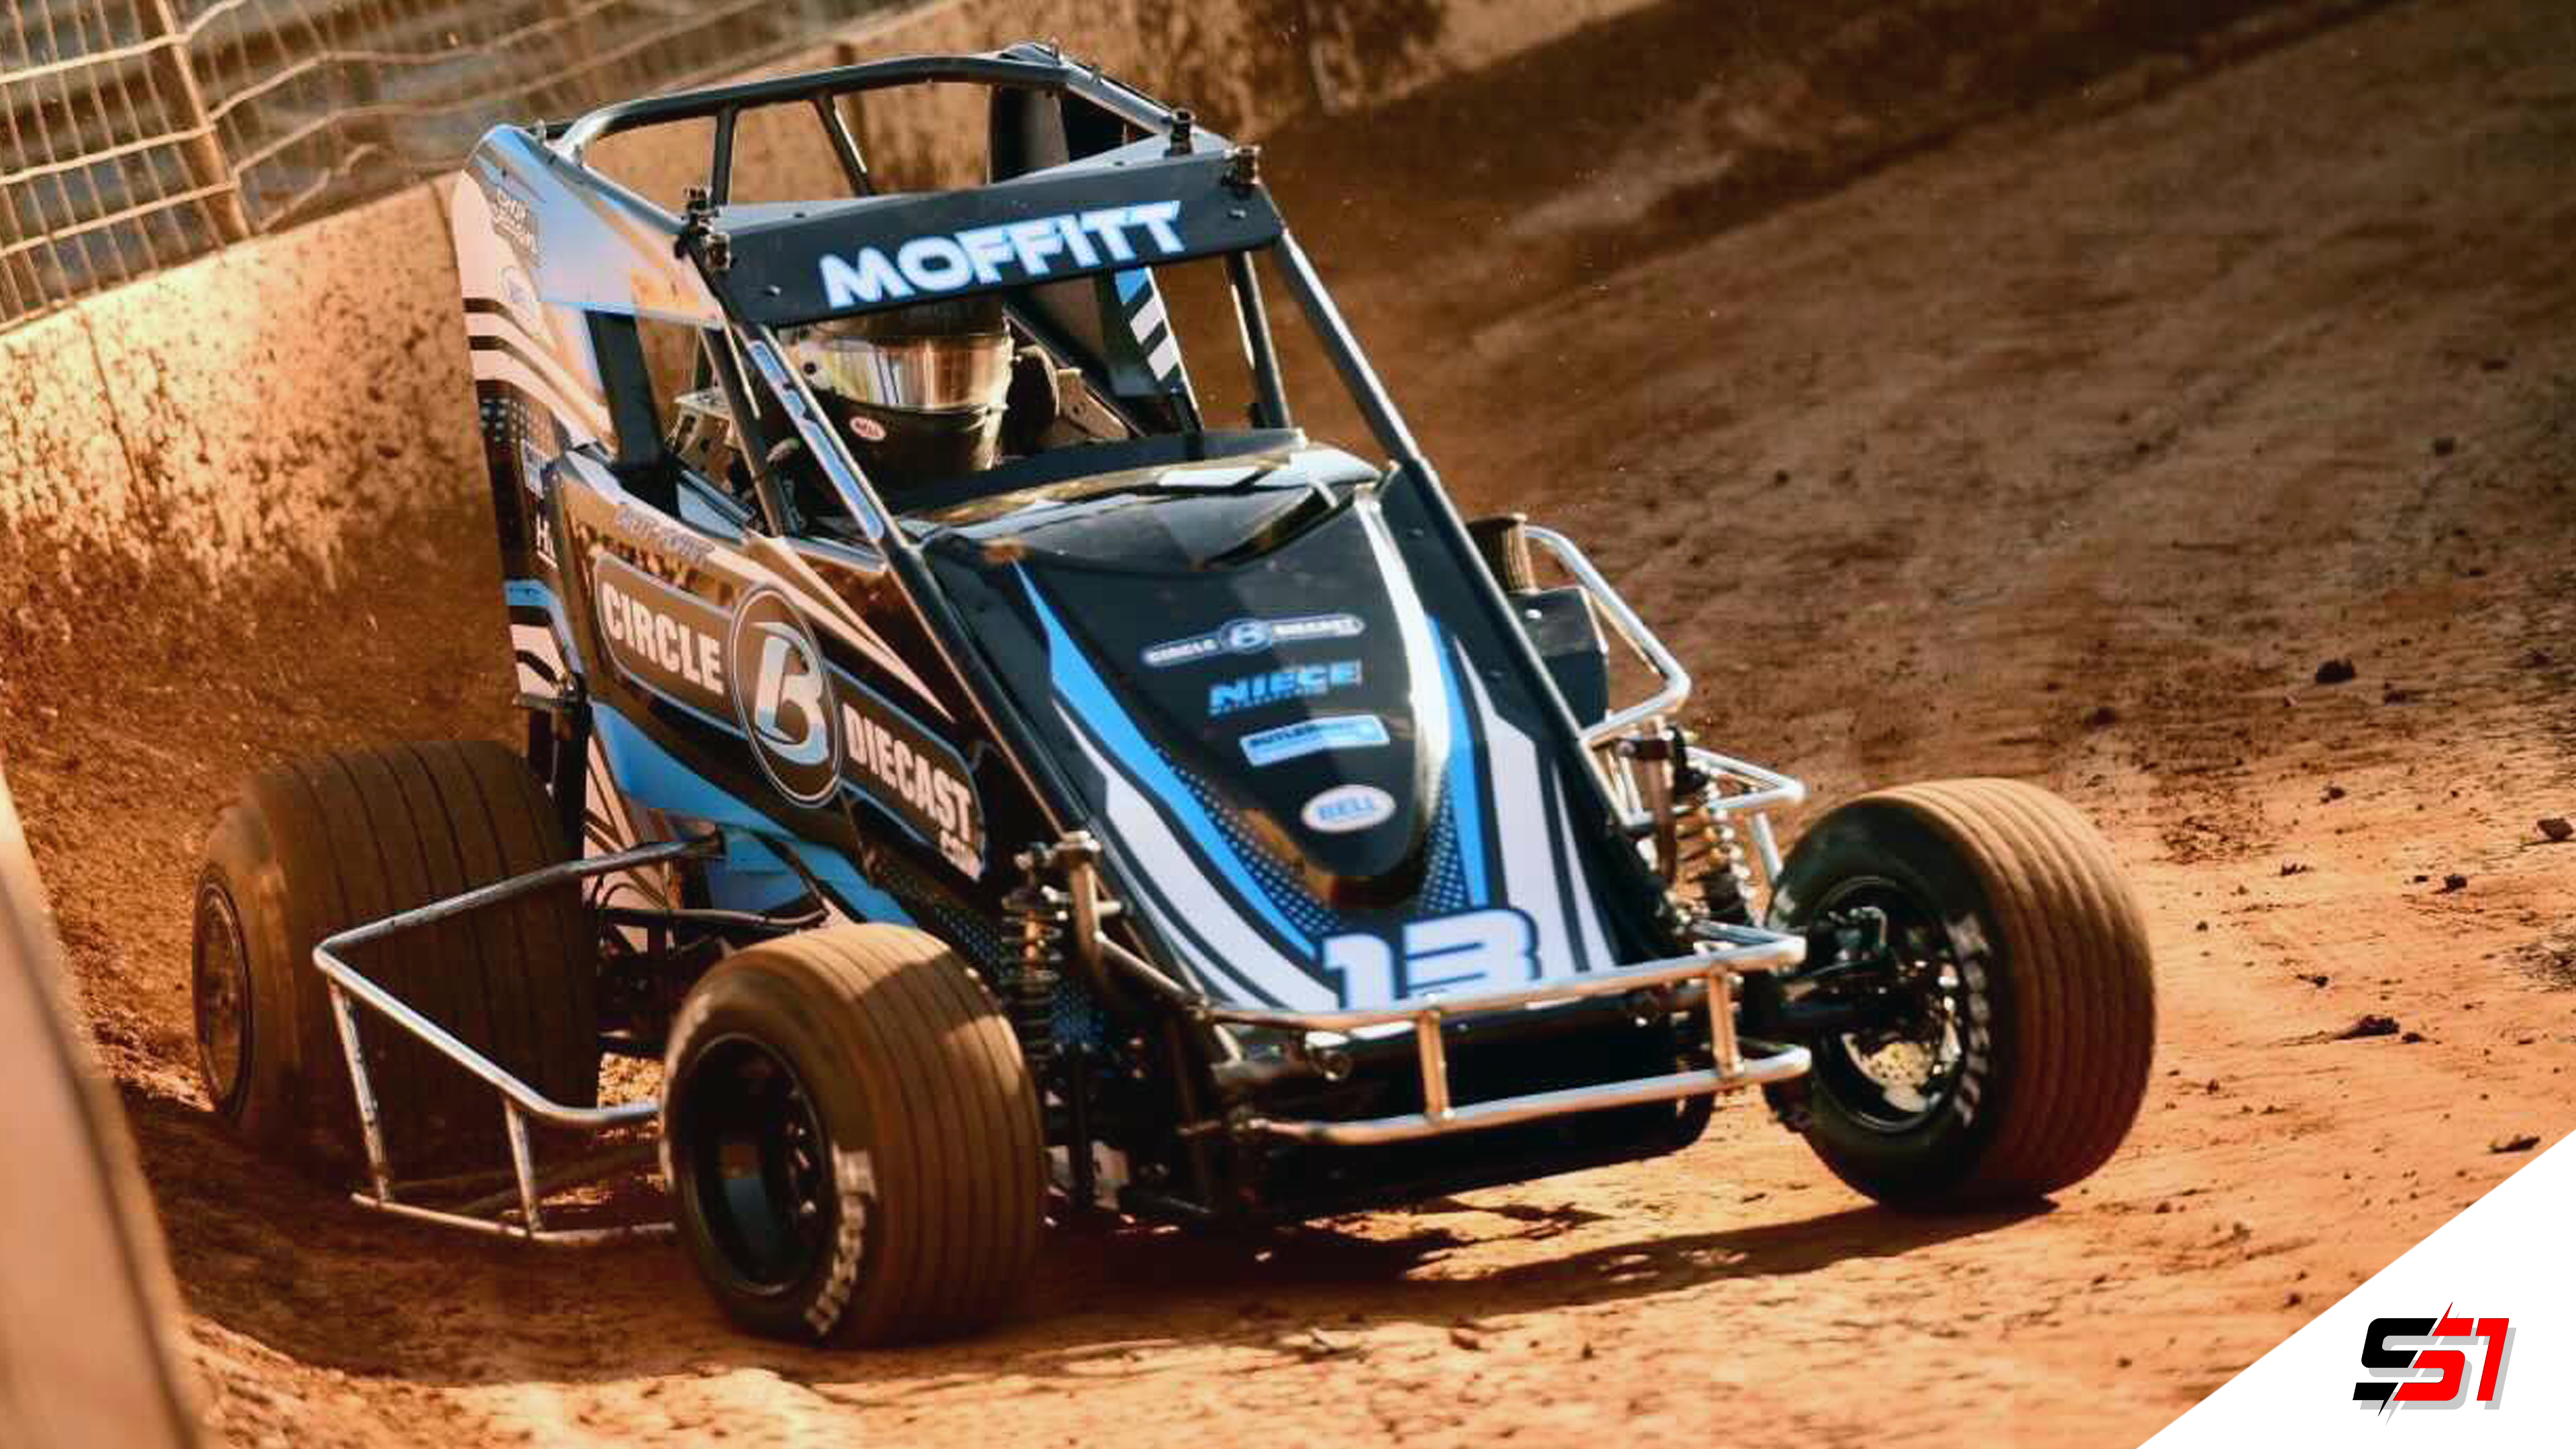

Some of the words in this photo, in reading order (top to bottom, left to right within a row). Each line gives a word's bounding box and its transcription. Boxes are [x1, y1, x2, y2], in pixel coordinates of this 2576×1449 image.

[818, 201, 1184, 309] MOFFITT
[602, 582, 724, 696] CIRCLE
[747, 621, 828, 765] B
[843, 702, 971, 845] DIECAST
[1210, 661, 1362, 708] NIECE
[1320, 796, 1374, 821] BELL
[1321, 908, 1540, 1012] 13
